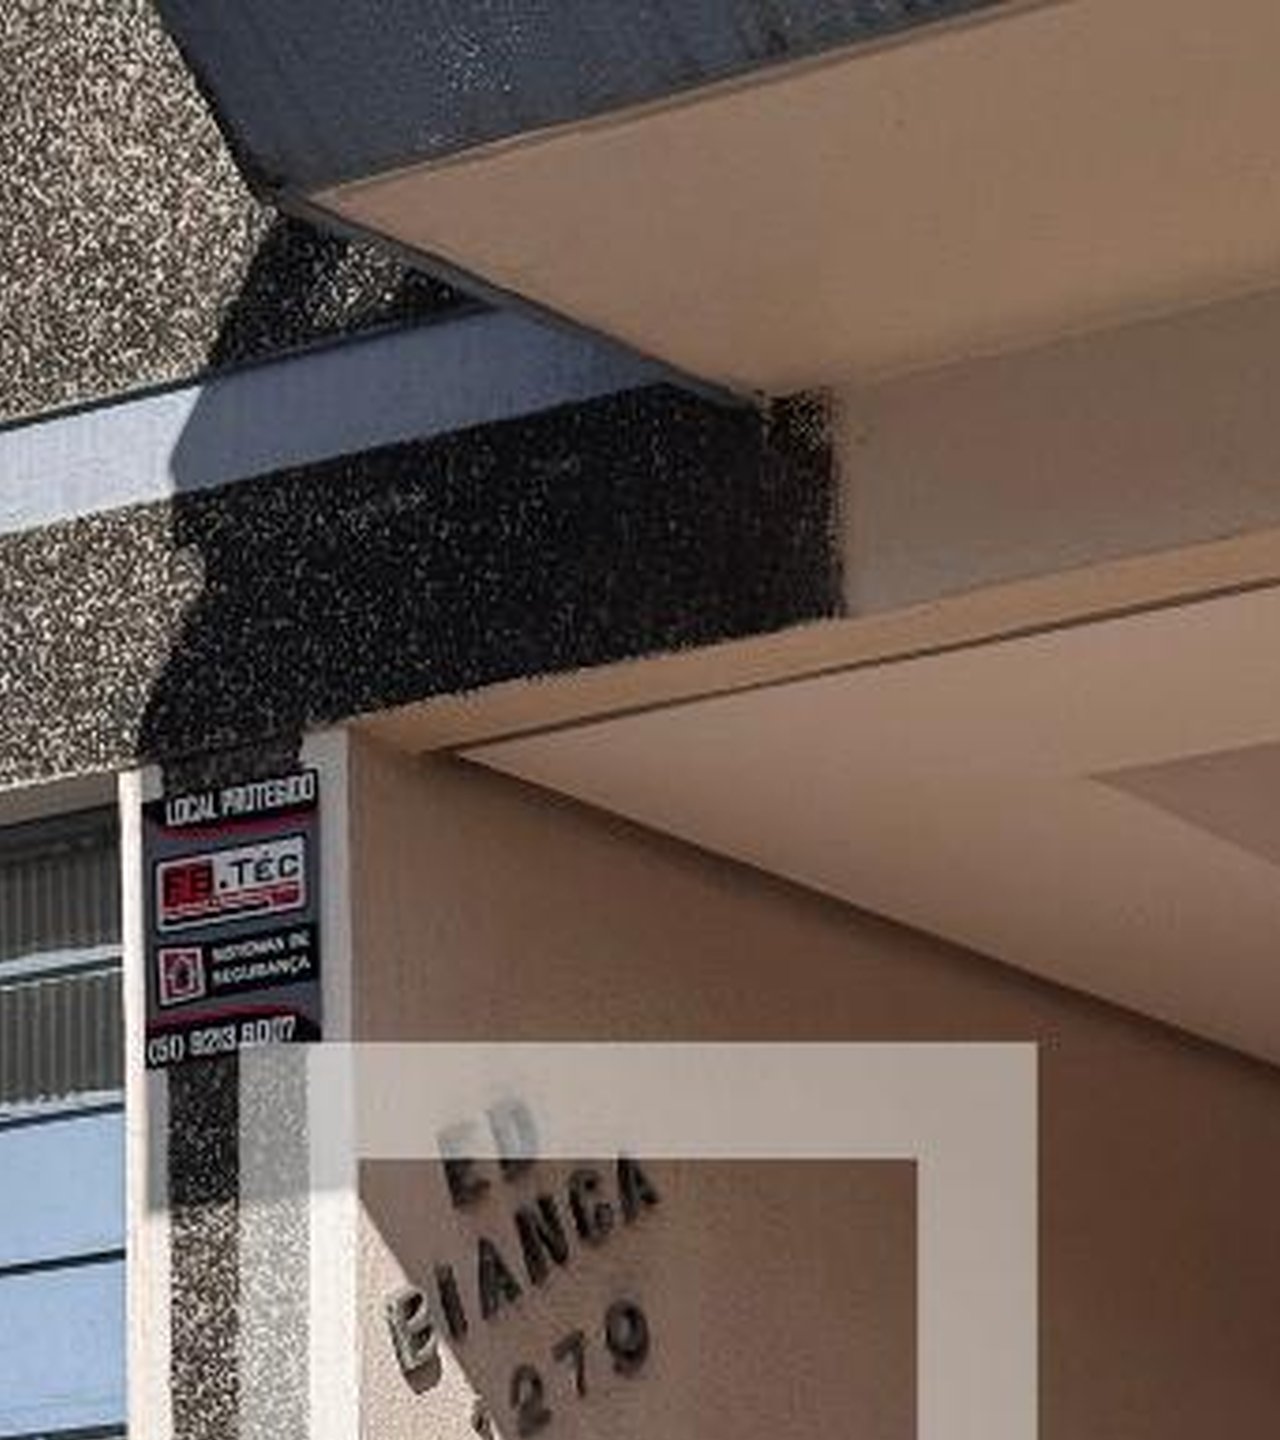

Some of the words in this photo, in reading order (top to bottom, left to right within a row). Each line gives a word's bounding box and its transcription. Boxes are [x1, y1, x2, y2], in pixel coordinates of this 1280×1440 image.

[166, 792, 218, 826] LOCAL
[221, 773, 315, 817] PROTEGIDO
[211, 953, 312, 984] SEGURANÇA
[148, 1034, 185, 1067] (51)
[387, 1150, 659, 1394] BIANCA
